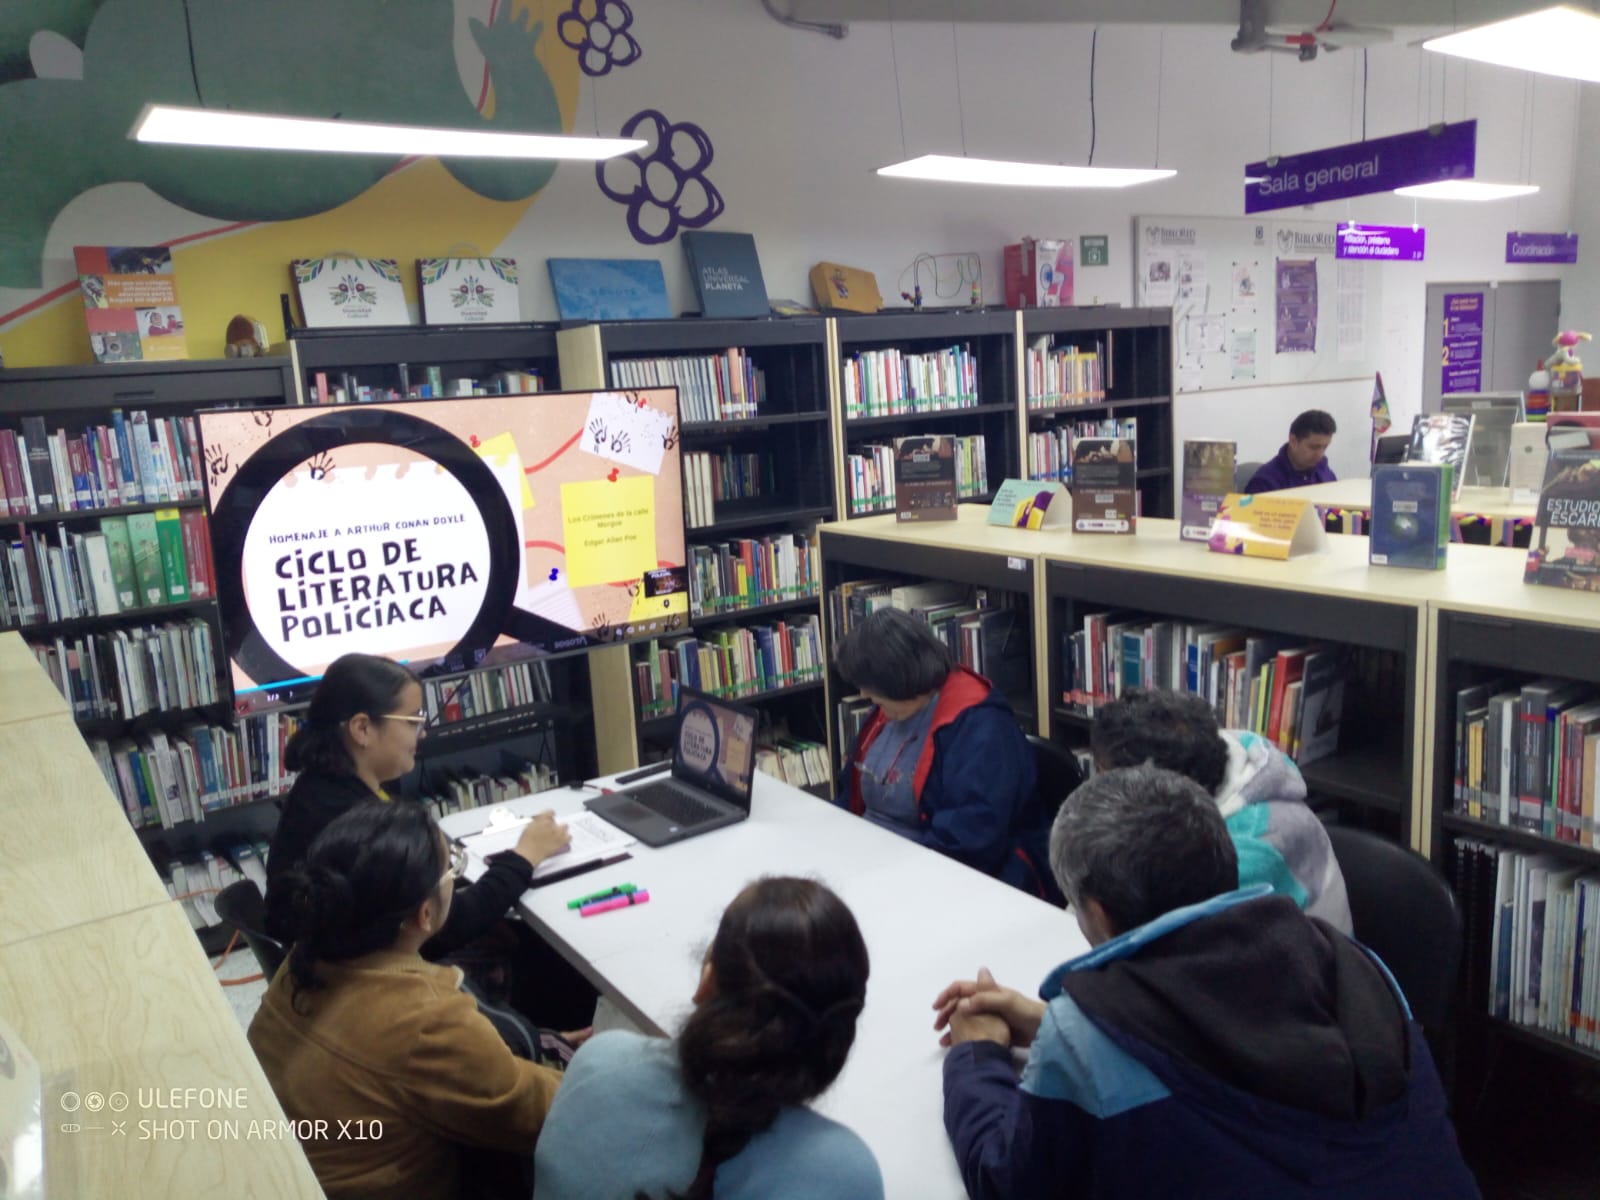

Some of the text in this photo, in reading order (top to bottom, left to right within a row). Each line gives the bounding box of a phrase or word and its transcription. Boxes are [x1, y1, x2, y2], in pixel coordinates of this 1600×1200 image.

[1258, 155, 1379, 196] Sala general
[704, 274, 750, 284] UNIVERSAL
[705, 283, 743, 291] PLANETA
[1443, 318, 1449, 337] 1
[1441, 346, 1449, 366] 2
[1547, 498, 1600, 513] ESTUDIO
[568, 516, 581, 524] Los
[597, 520, 623, 529] Morgue
[269, 513, 466, 544] HOMENAJE A ARTHUR CONAN DOYLE
[584, 534, 637, 547] Edgar Allan Poe
[382, 538, 422, 566] DE
